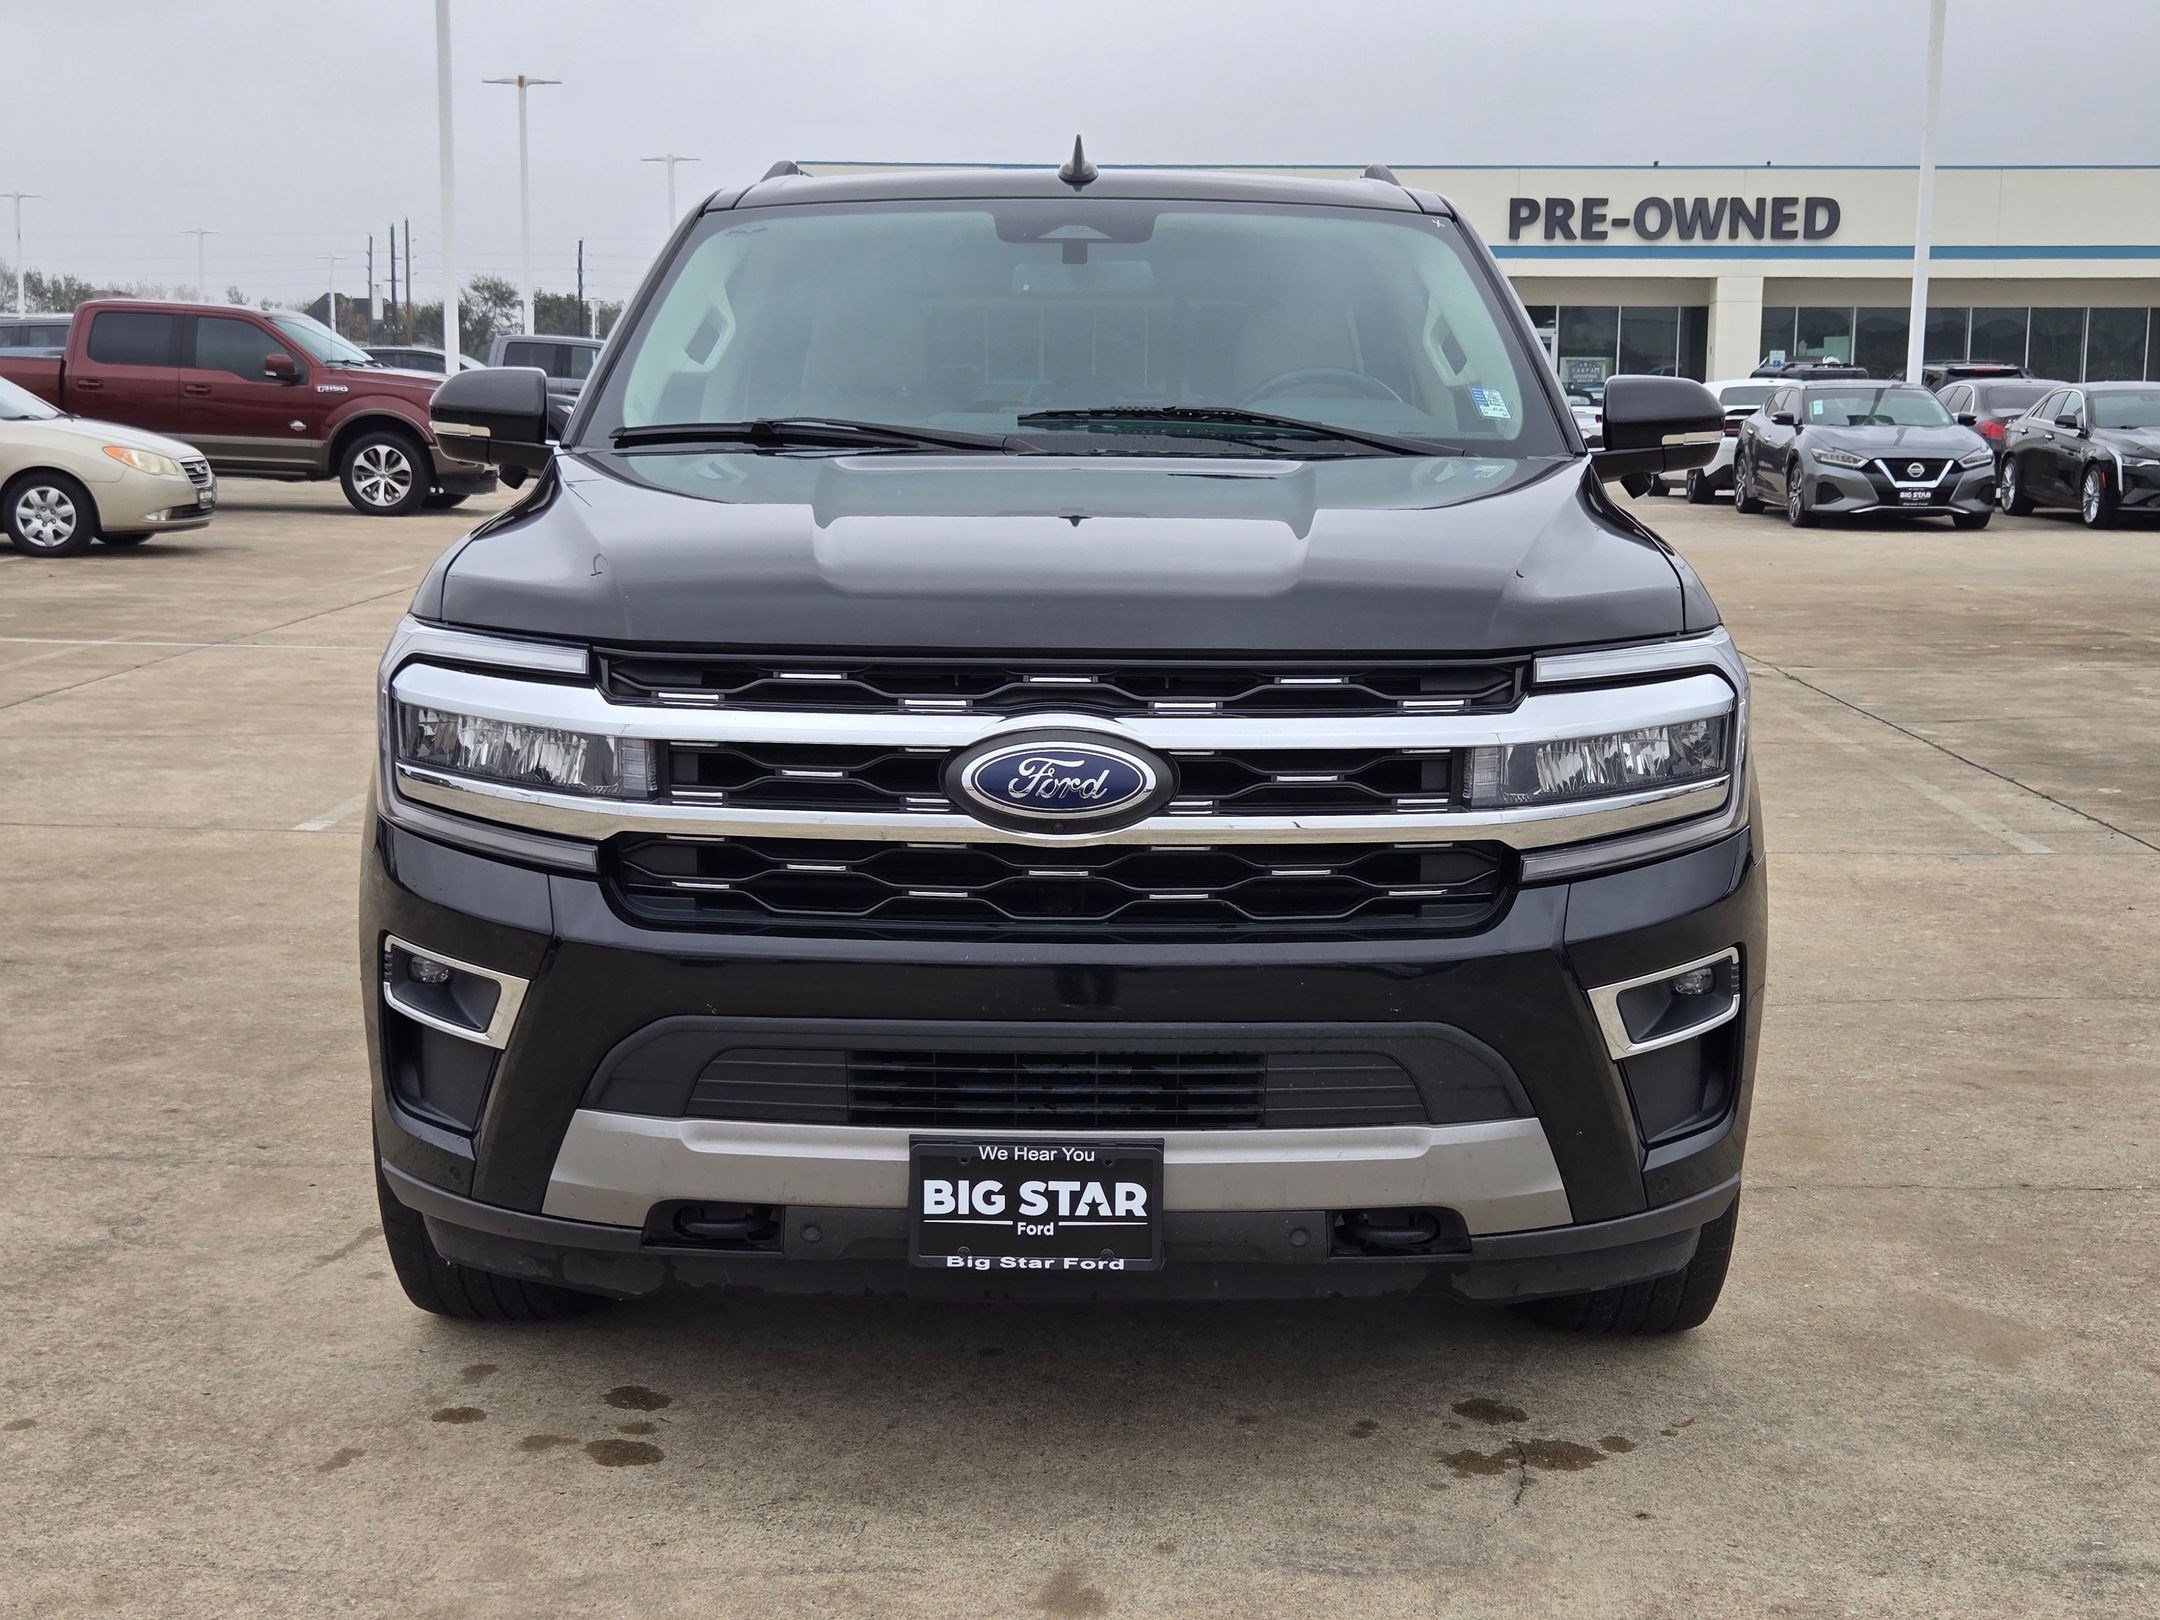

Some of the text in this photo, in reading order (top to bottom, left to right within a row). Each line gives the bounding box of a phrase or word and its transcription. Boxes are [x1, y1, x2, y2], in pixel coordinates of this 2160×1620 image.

[1508, 197, 1841, 241] PRE-OWNED
[1008, 757, 1110, 799] Ford
[978, 1145, 1095, 1162] We Hear You
[923, 1179, 1148, 1217] BIG STAR
[1017, 1222, 1054, 1236] Ford
[946, 1255, 1125, 1271] Big Star Ford
